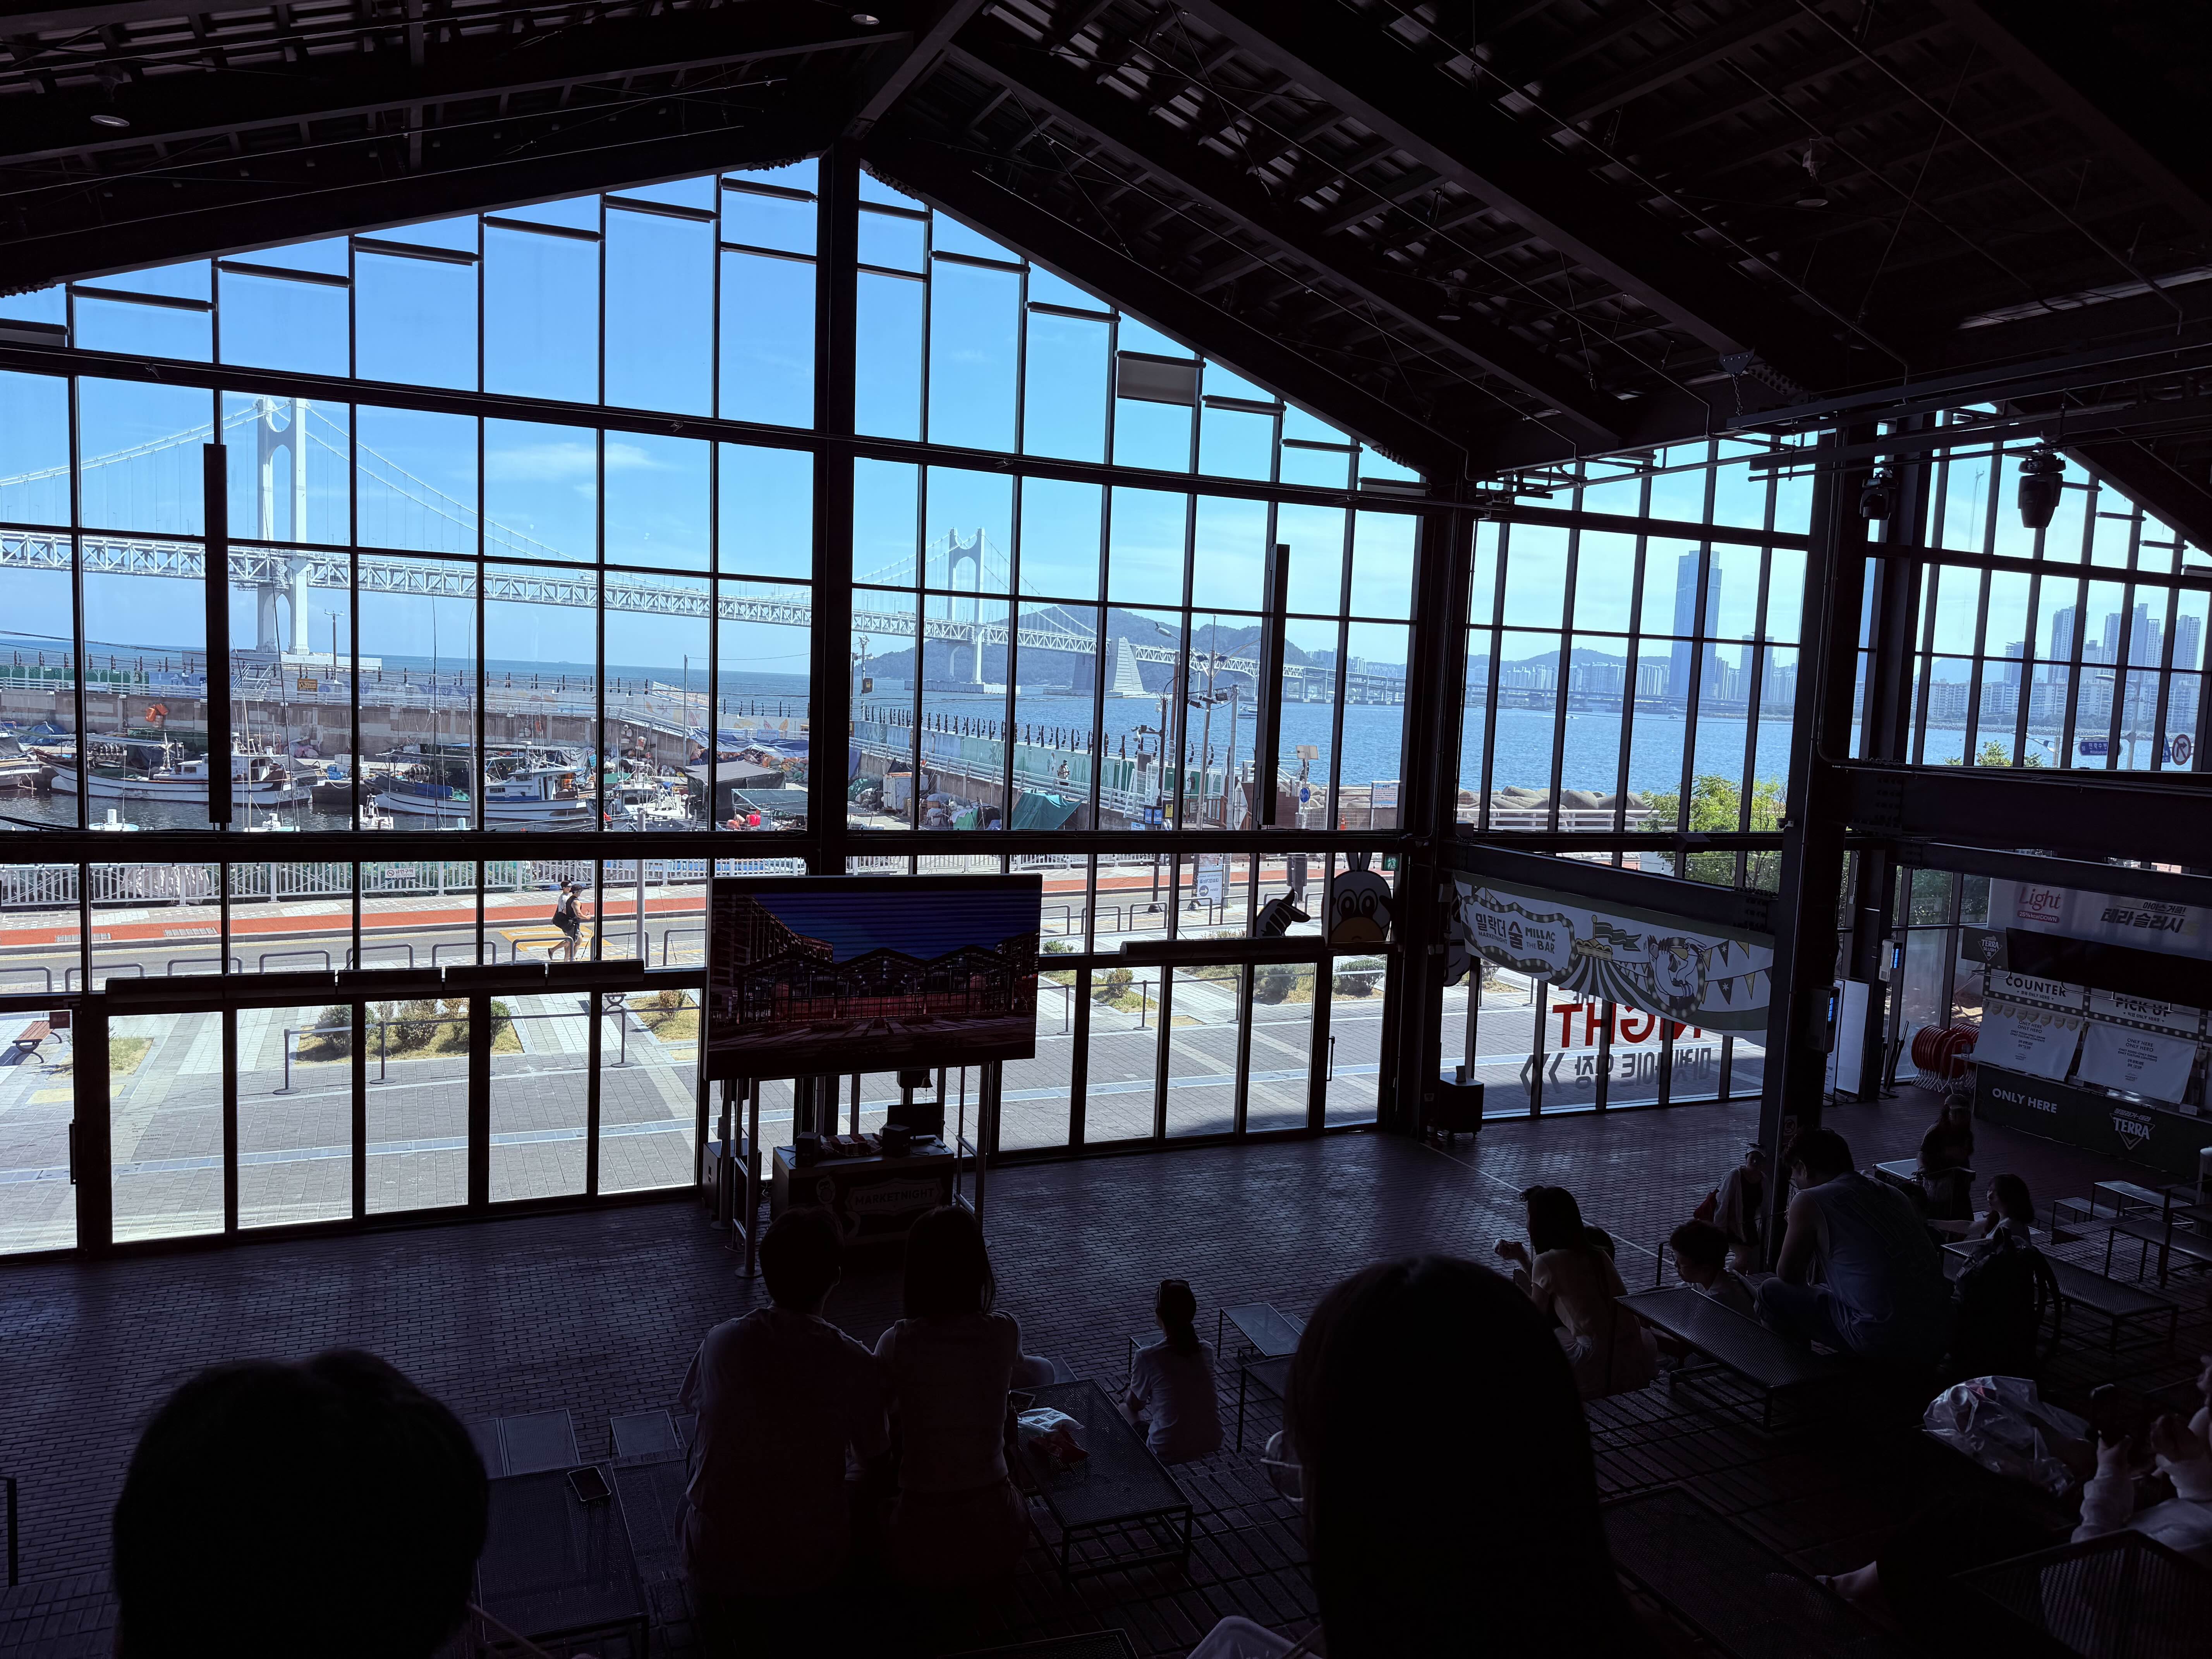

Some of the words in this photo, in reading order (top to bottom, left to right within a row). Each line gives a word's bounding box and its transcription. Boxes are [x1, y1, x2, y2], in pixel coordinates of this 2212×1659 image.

[2019, 887, 2061, 910] Light
[2100, 908, 2134, 925] 테라
[2133, 913, 2185, 933] 슬러시
[1478, 931, 1508, 945] MARKETNIGHT
[1525, 927, 1556, 942] MILLAC
[1981, 939, 1999, 949] TERRA
[1537, 940, 1555, 954] BAR
[2006, 976, 2066, 997] COUNTER
[2115, 997, 2147, 1013] PICK
[2152, 1003, 2171, 1017] UP
[1992, 1087, 2025, 1104] ONLY
[2027, 1097, 2057, 1114] HERE
[2113, 1116, 2150, 1140] TERRA
[855, 1188, 934, 1206] MARKETNIGHT
